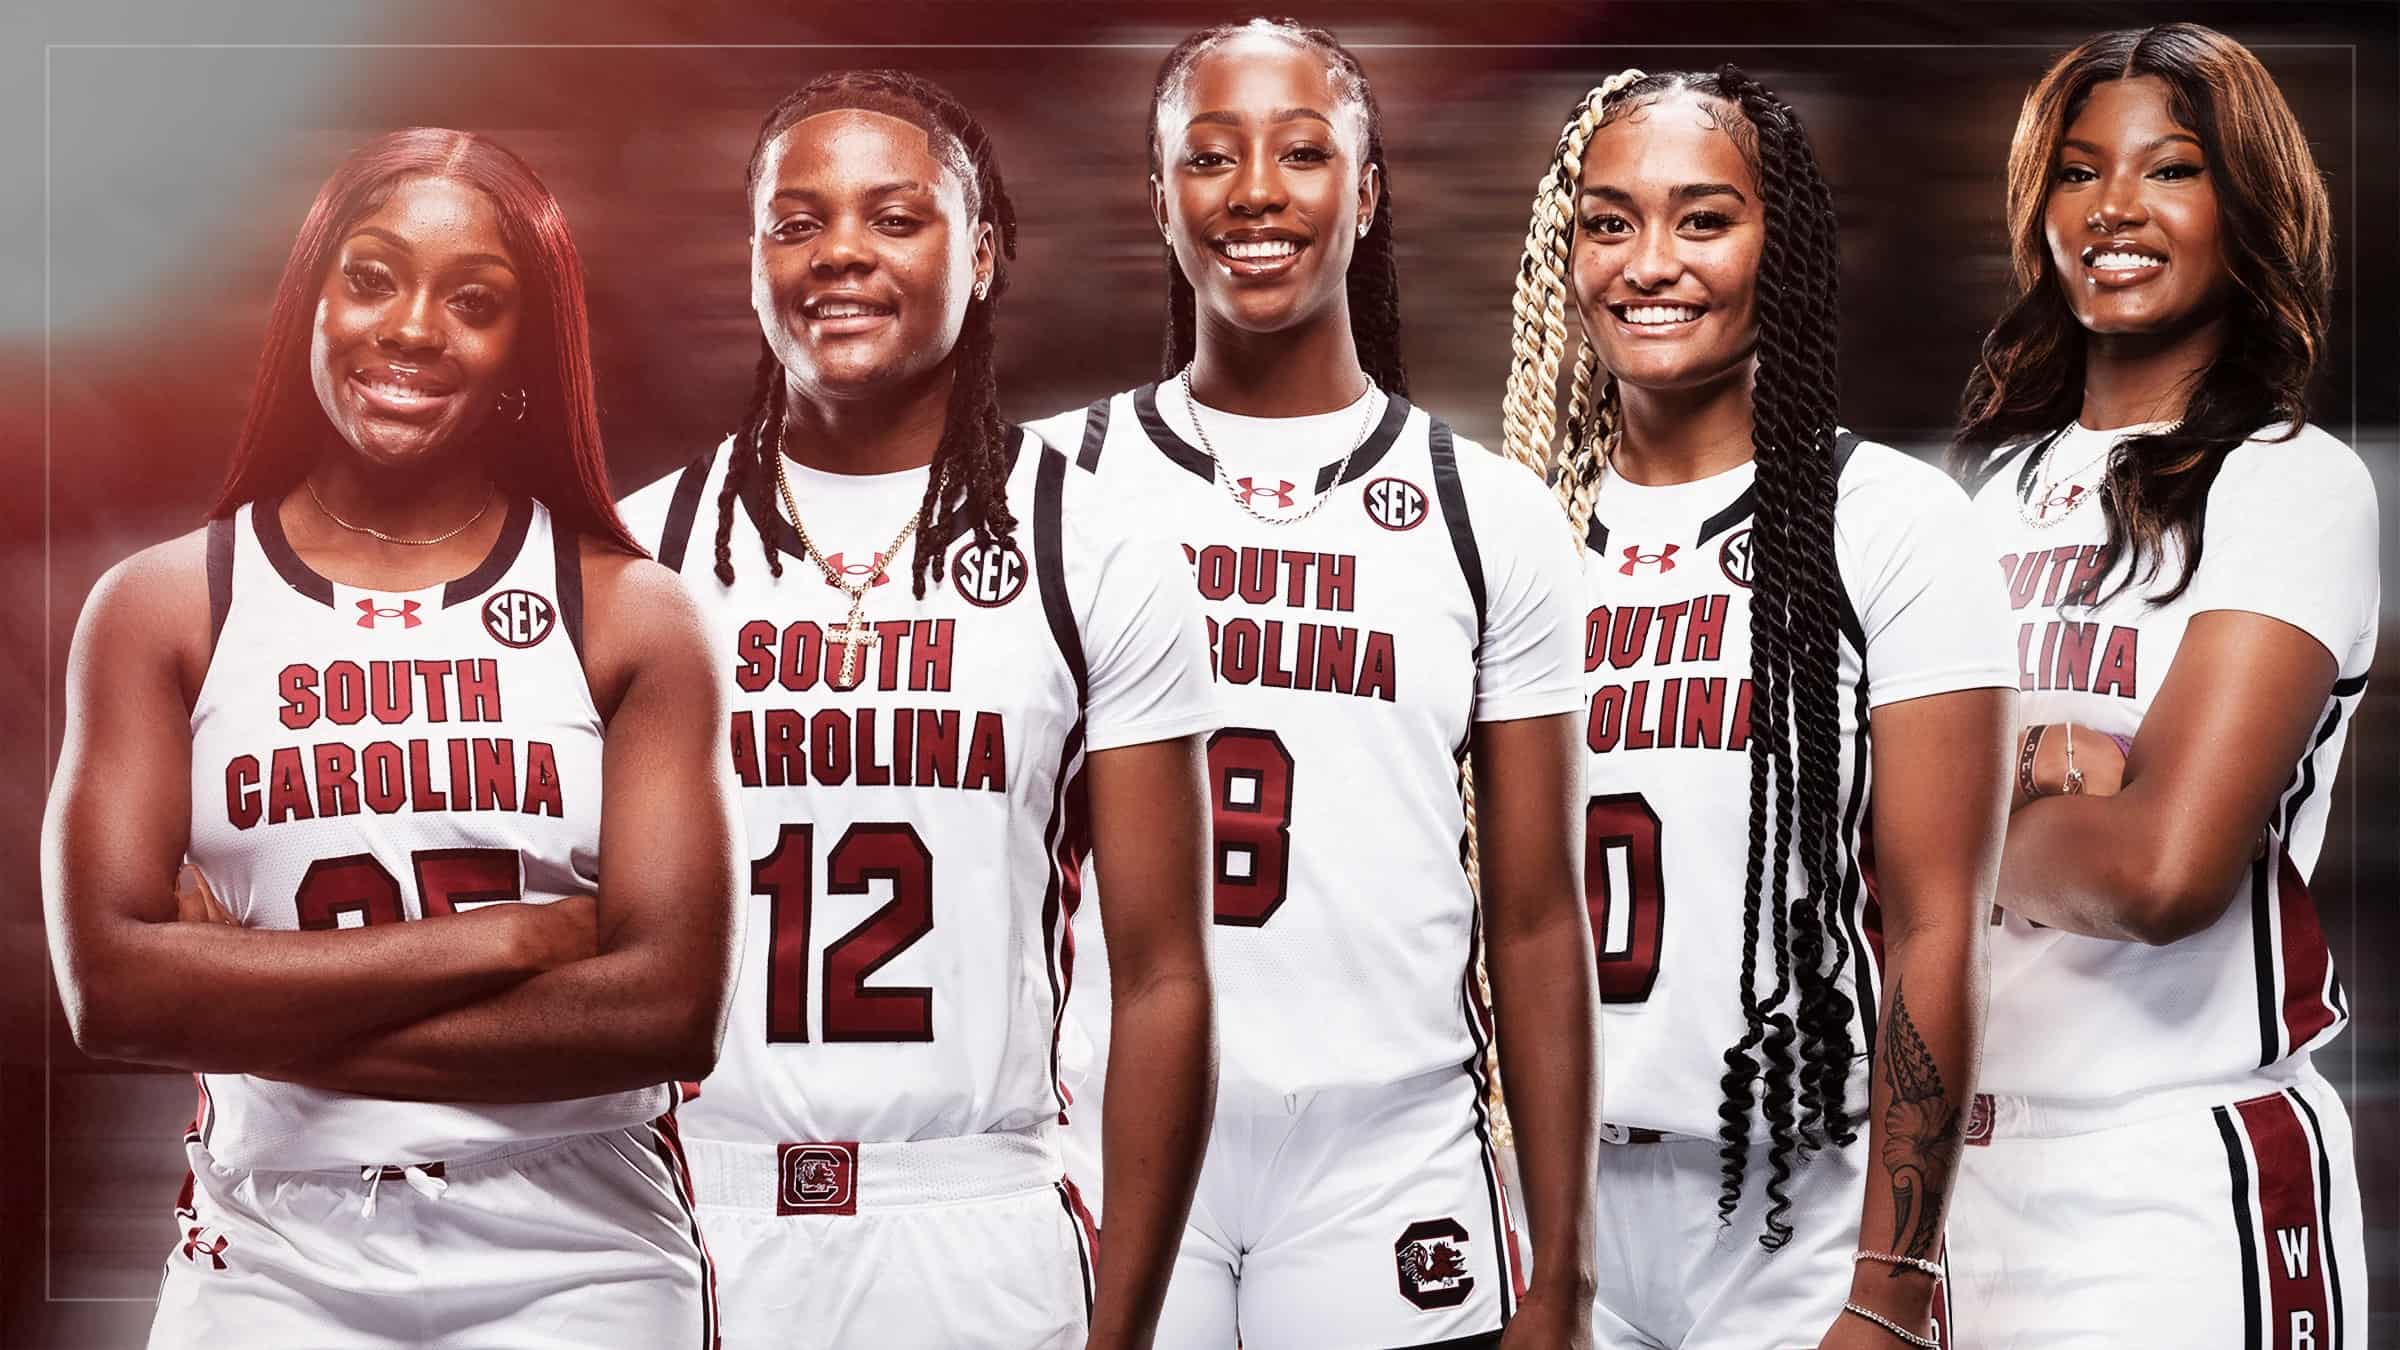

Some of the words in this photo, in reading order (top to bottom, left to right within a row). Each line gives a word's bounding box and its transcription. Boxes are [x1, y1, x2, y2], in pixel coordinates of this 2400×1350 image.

[1369, 480, 1423, 527] SEC
[959, 546, 1023, 600] SEC
[1181, 543, 1356, 612] OUTH
[488, 591, 549, 643] SEC
[1584, 594, 1730, 673] OUTH
[736, 619, 956, 692] SOUTH
[278, 658, 502, 730] SOUTH
[225, 738, 564, 831] CAROLINA
[1207, 727, 1295, 928] 8
[751, 822, 934, 1043] 12
[1584, 792, 1665, 1004] 0
